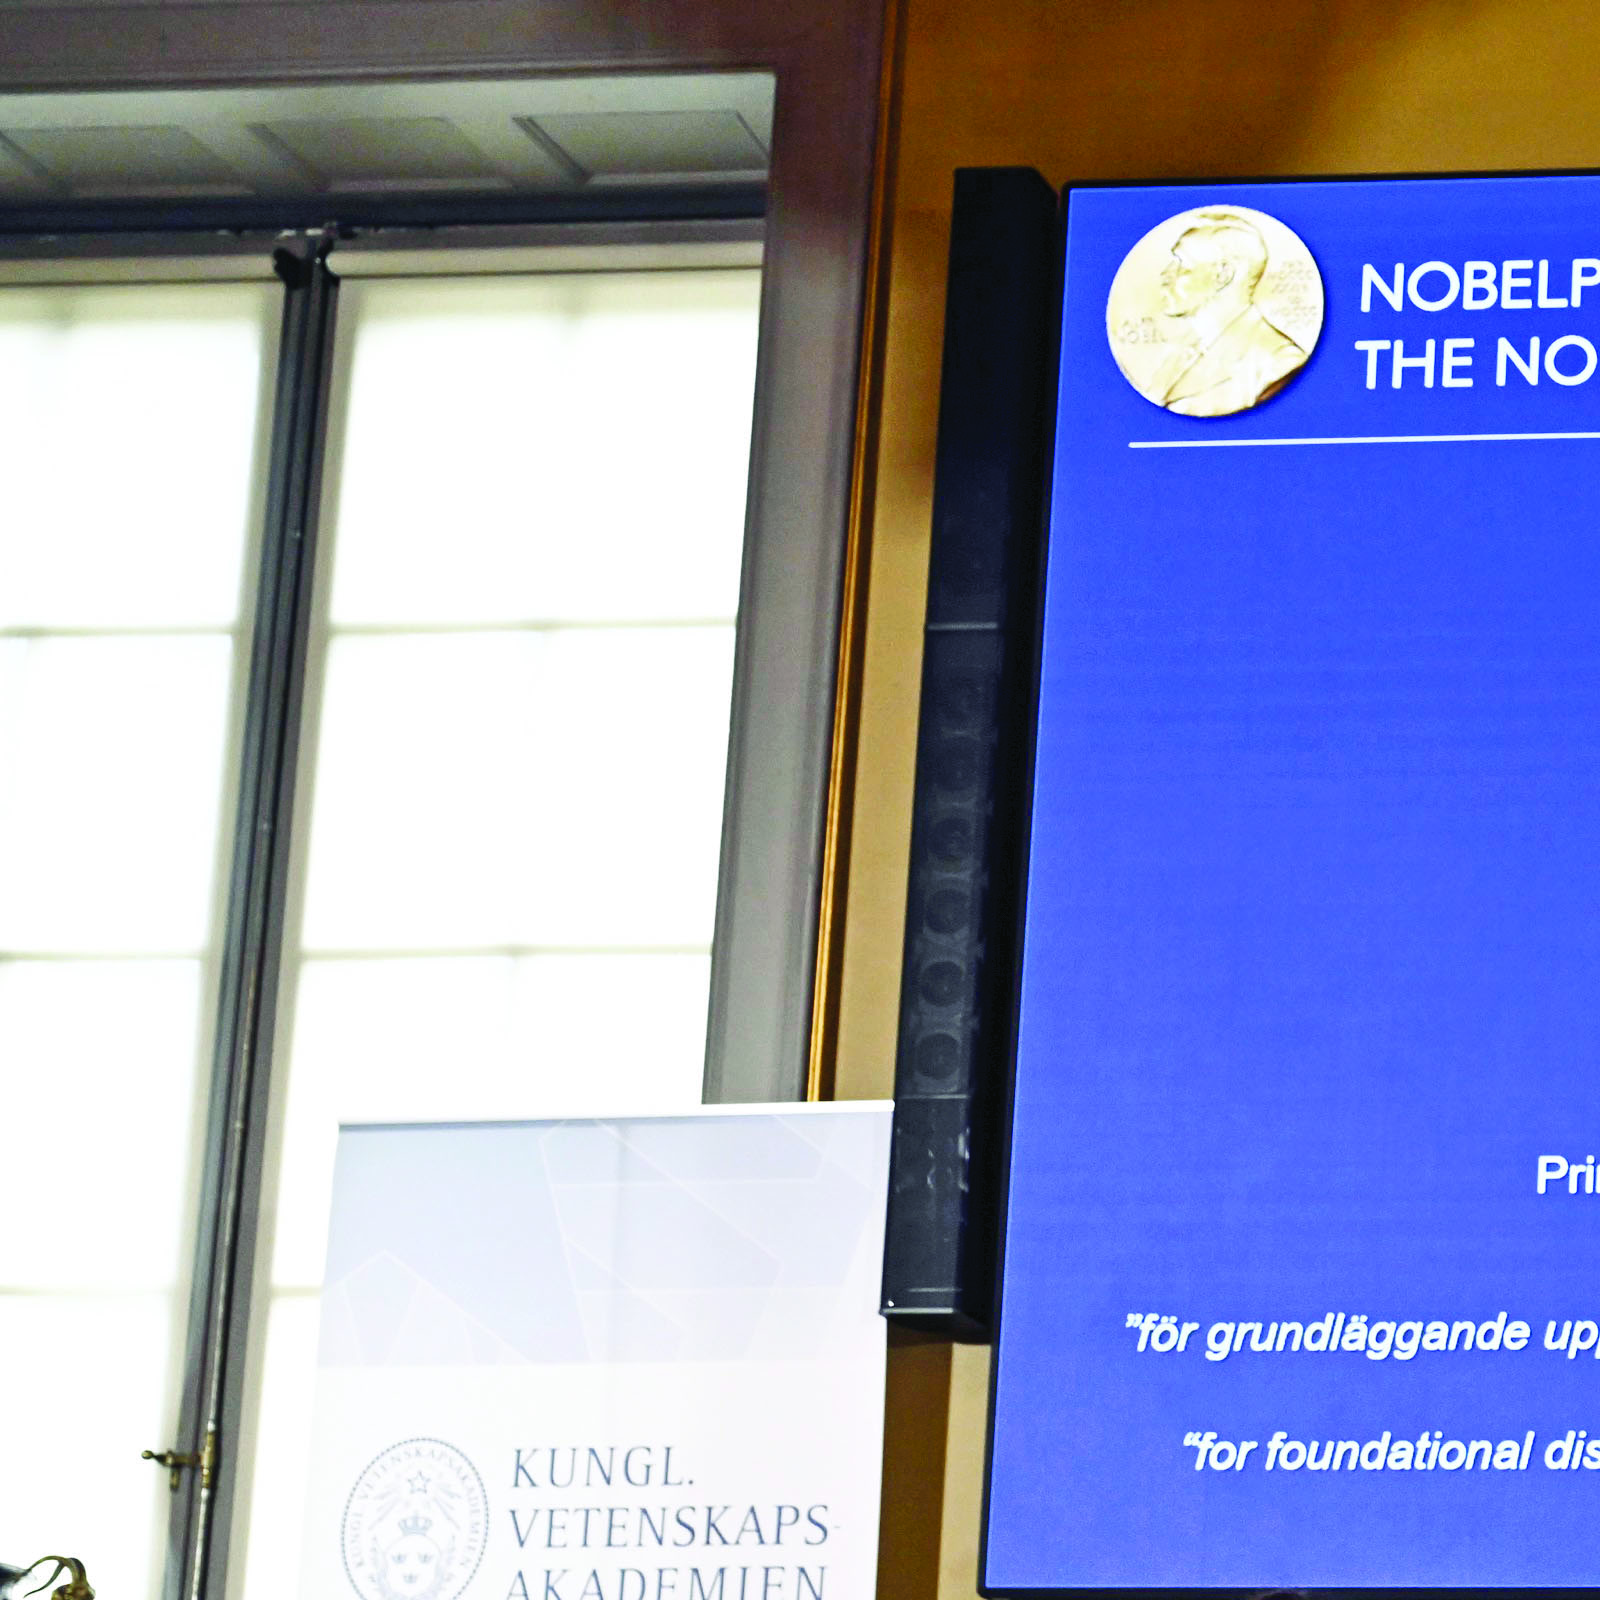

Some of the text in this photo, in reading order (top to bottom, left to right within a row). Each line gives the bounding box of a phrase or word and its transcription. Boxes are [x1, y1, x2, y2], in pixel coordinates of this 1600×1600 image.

[1355, 338, 1474, 389] THE
[1205, 1312, 1530, 1361] grundläggande
[514, 1447, 693, 1487] KUNGL.
[1265, 1431, 1535, 1470] foundational
